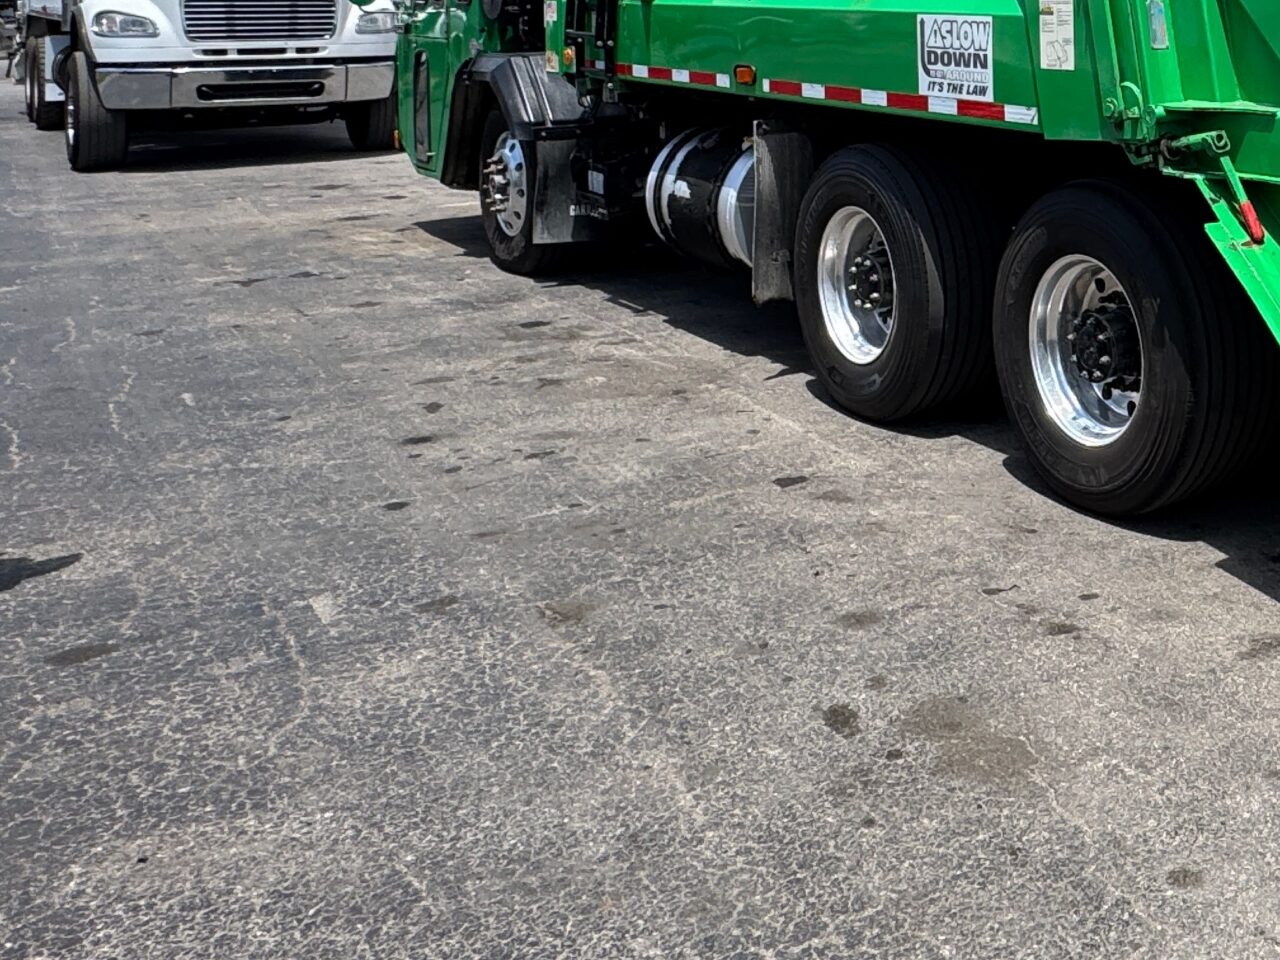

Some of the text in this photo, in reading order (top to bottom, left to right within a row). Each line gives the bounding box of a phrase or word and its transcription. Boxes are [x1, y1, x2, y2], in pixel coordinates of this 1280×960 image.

[940, 20, 990, 51] SLOW
[926, 50, 988, 69] DOWN
[945, 69, 989, 83] AROUND
[927, 81, 988, 97] IT'S THE LAW
